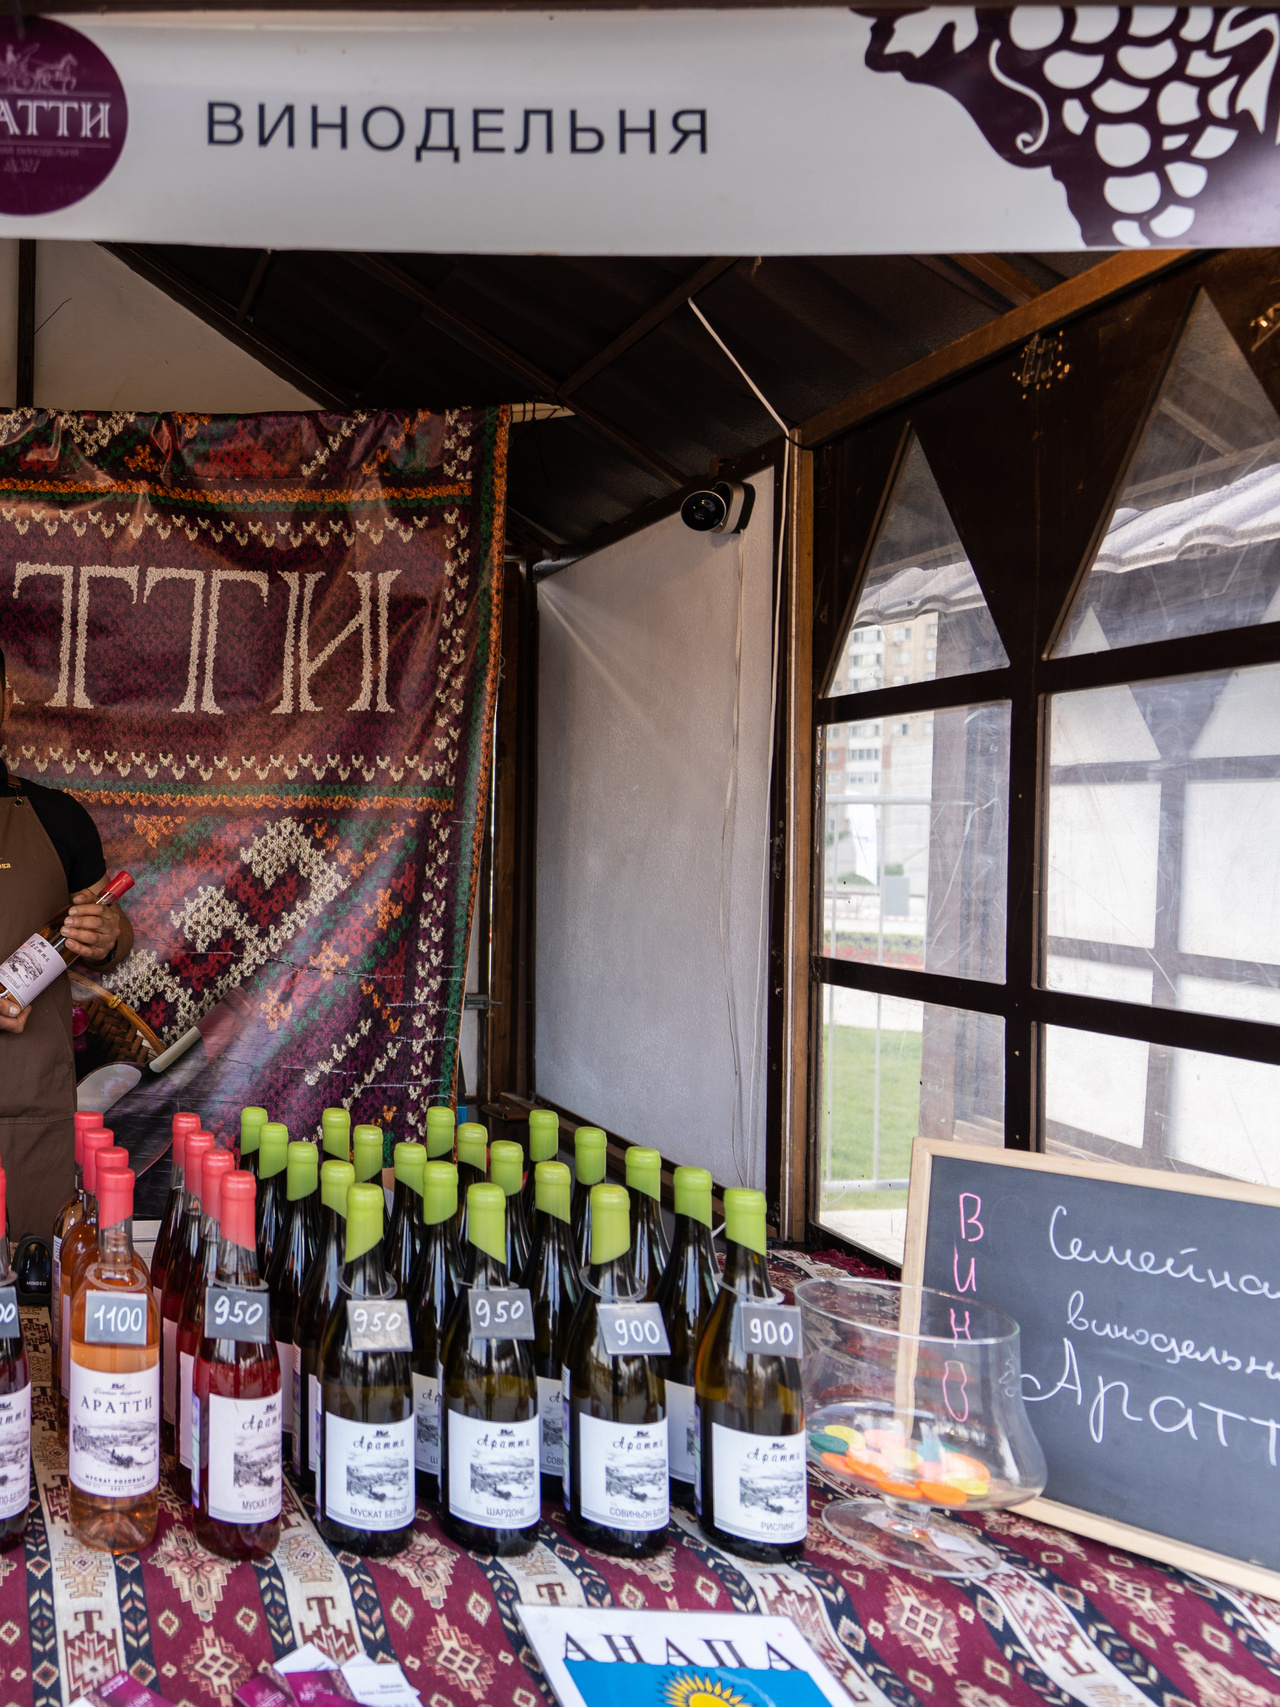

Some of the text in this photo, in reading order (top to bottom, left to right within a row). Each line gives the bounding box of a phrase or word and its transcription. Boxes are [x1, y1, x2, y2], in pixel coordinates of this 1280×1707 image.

[204, 100, 712, 162] ВИНОДЕЛЬНЯ
[94, 1304, 143, 1333] 1100
[214, 1295, 263, 1325] 950
[353, 1308, 401, 1333] 950
[475, 1298, 524, 1327] 950
[942, 1193, 985, 1422] ВИНО
[614, 1318, 661, 1346] 900
[749, 1317, 794, 1346] 900
[81, 1395, 153, 1414] АРАТТИ
[350, 1506, 382, 1519] МУСКАТ
[486, 1505, 526, 1518] ШАРДОНЕ
[610, 1507, 652, 1519] СОВИНЬОН
[761, 1521, 795, 1532] РИСЛИНГ
[562, 1631, 800, 1672] АНАПА
